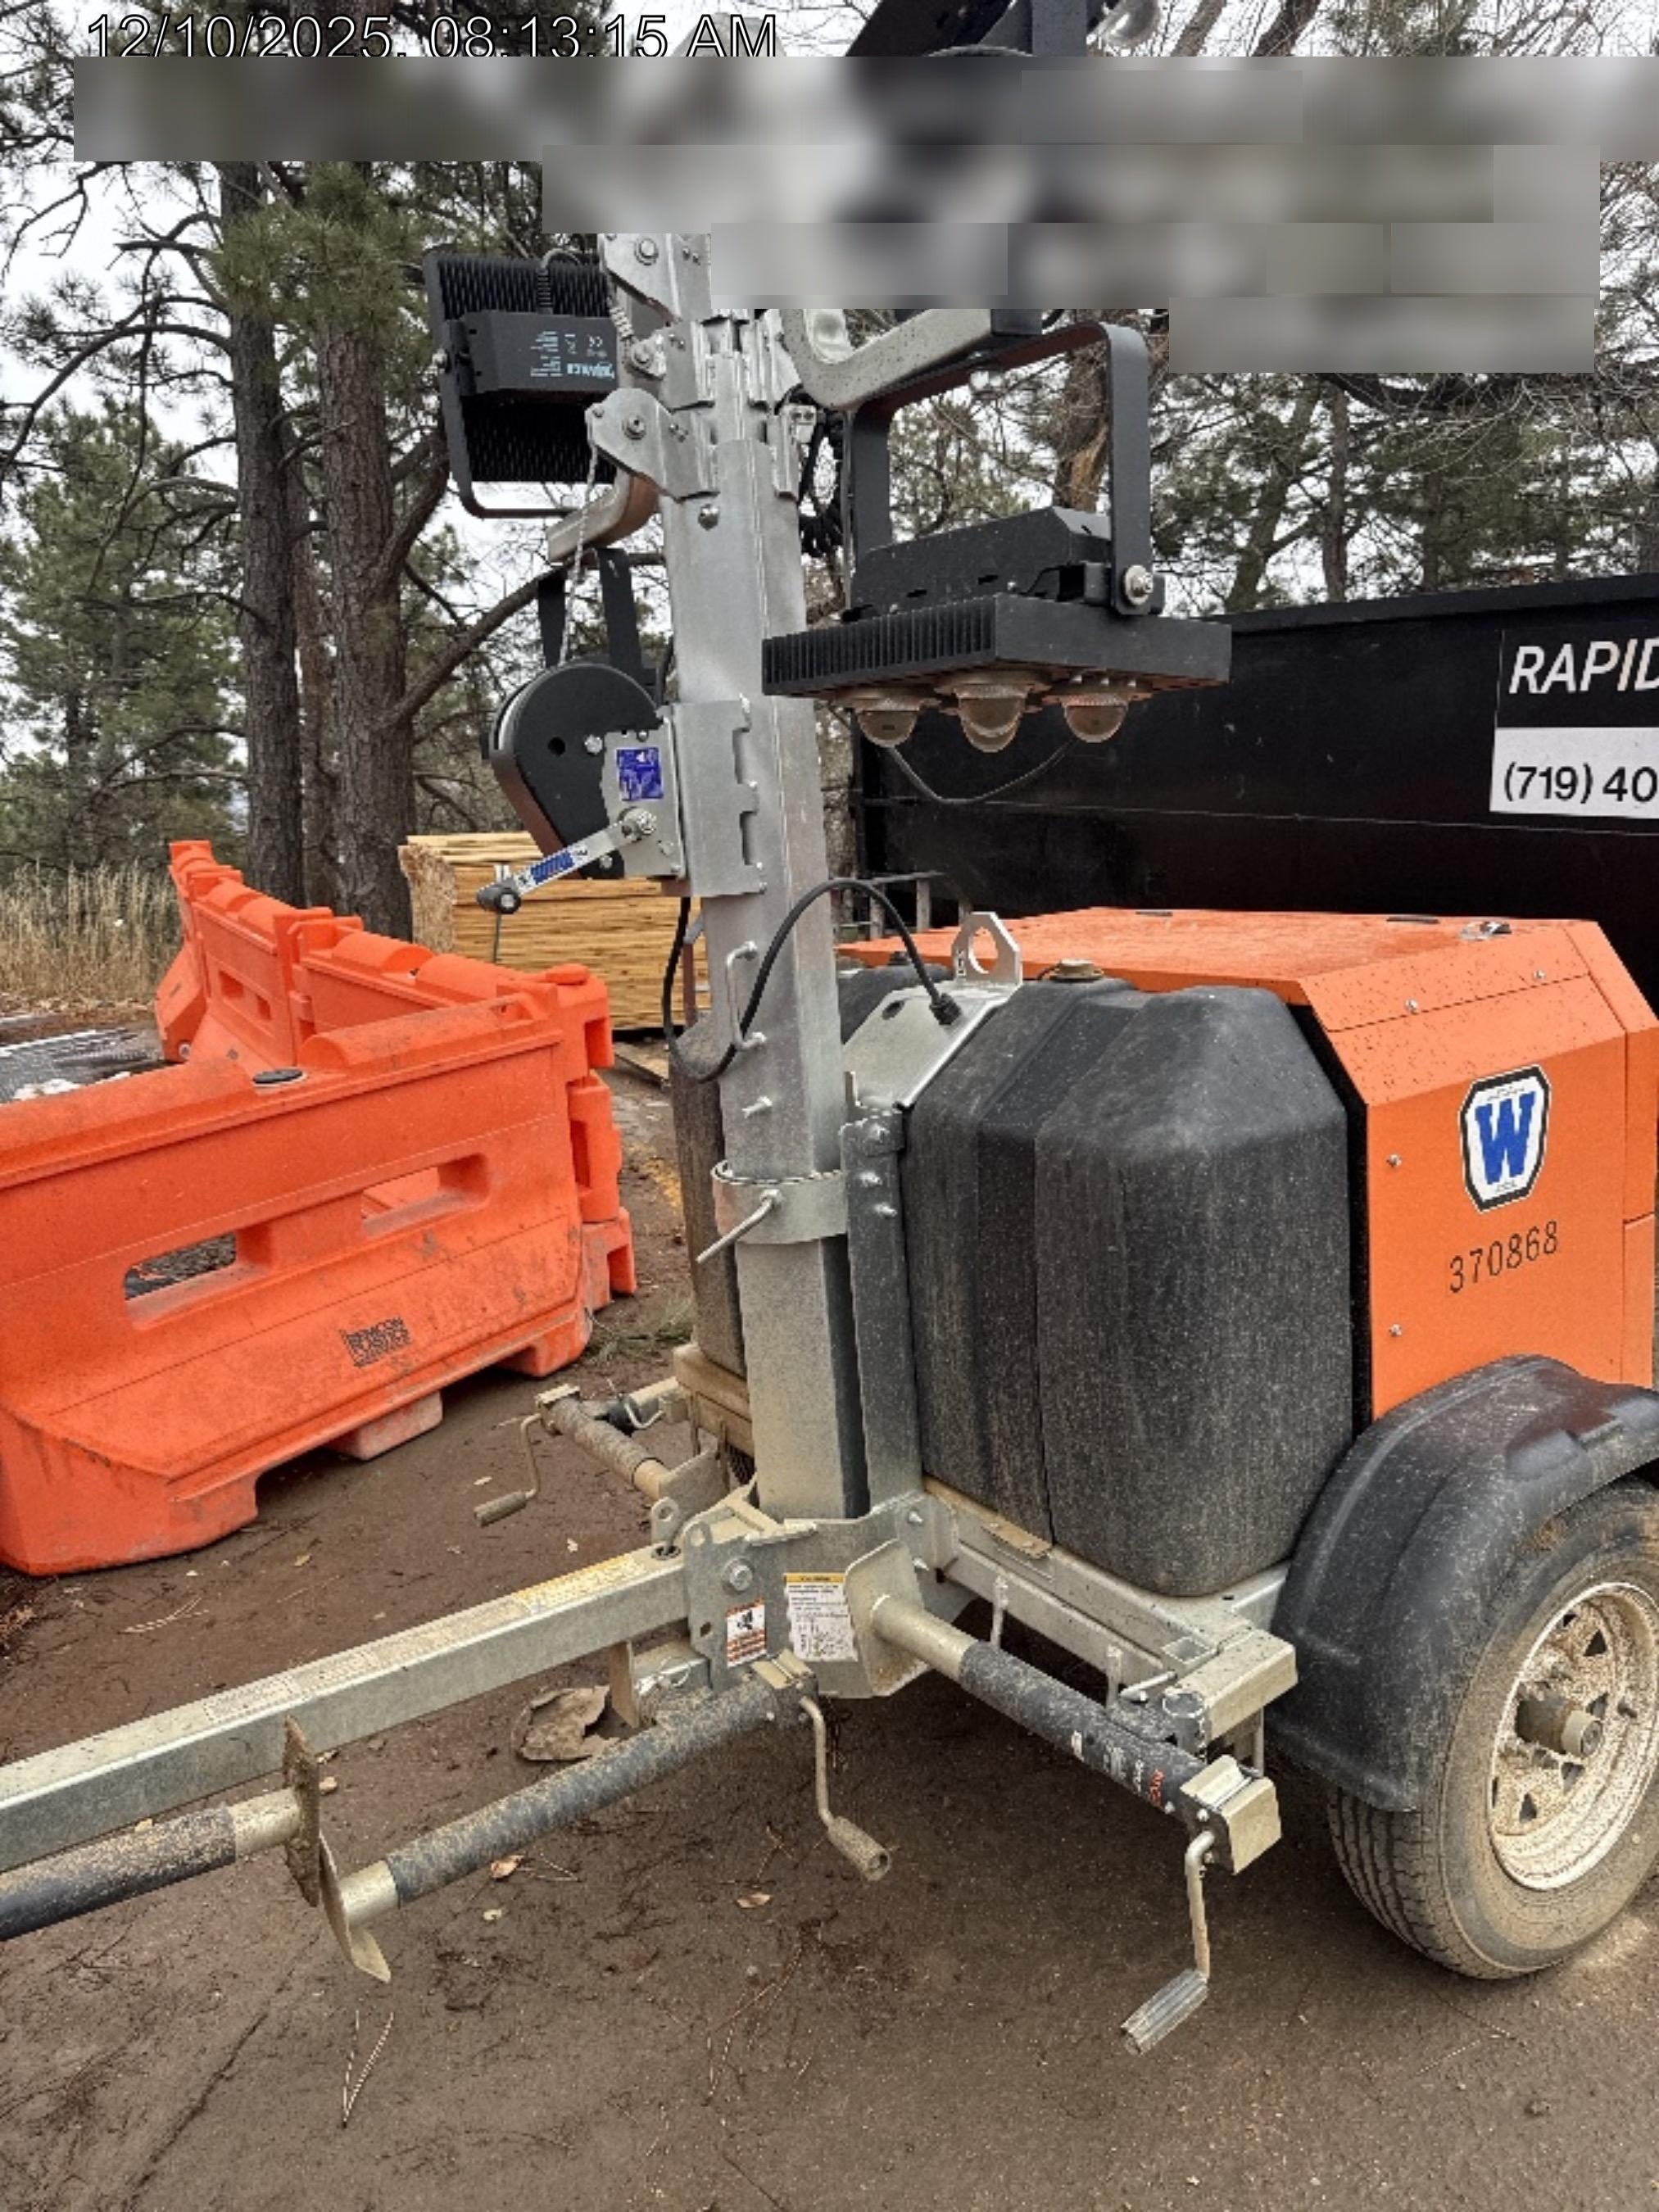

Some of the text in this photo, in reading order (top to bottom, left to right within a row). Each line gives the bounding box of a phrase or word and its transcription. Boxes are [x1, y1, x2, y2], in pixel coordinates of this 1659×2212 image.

[1508, 638, 1659, 694] RAPID
[1504, 762, 1658, 804] (719) 40
[1475, 1091, 1536, 1185] W
[1449, 1220, 1558, 1294] 370868
